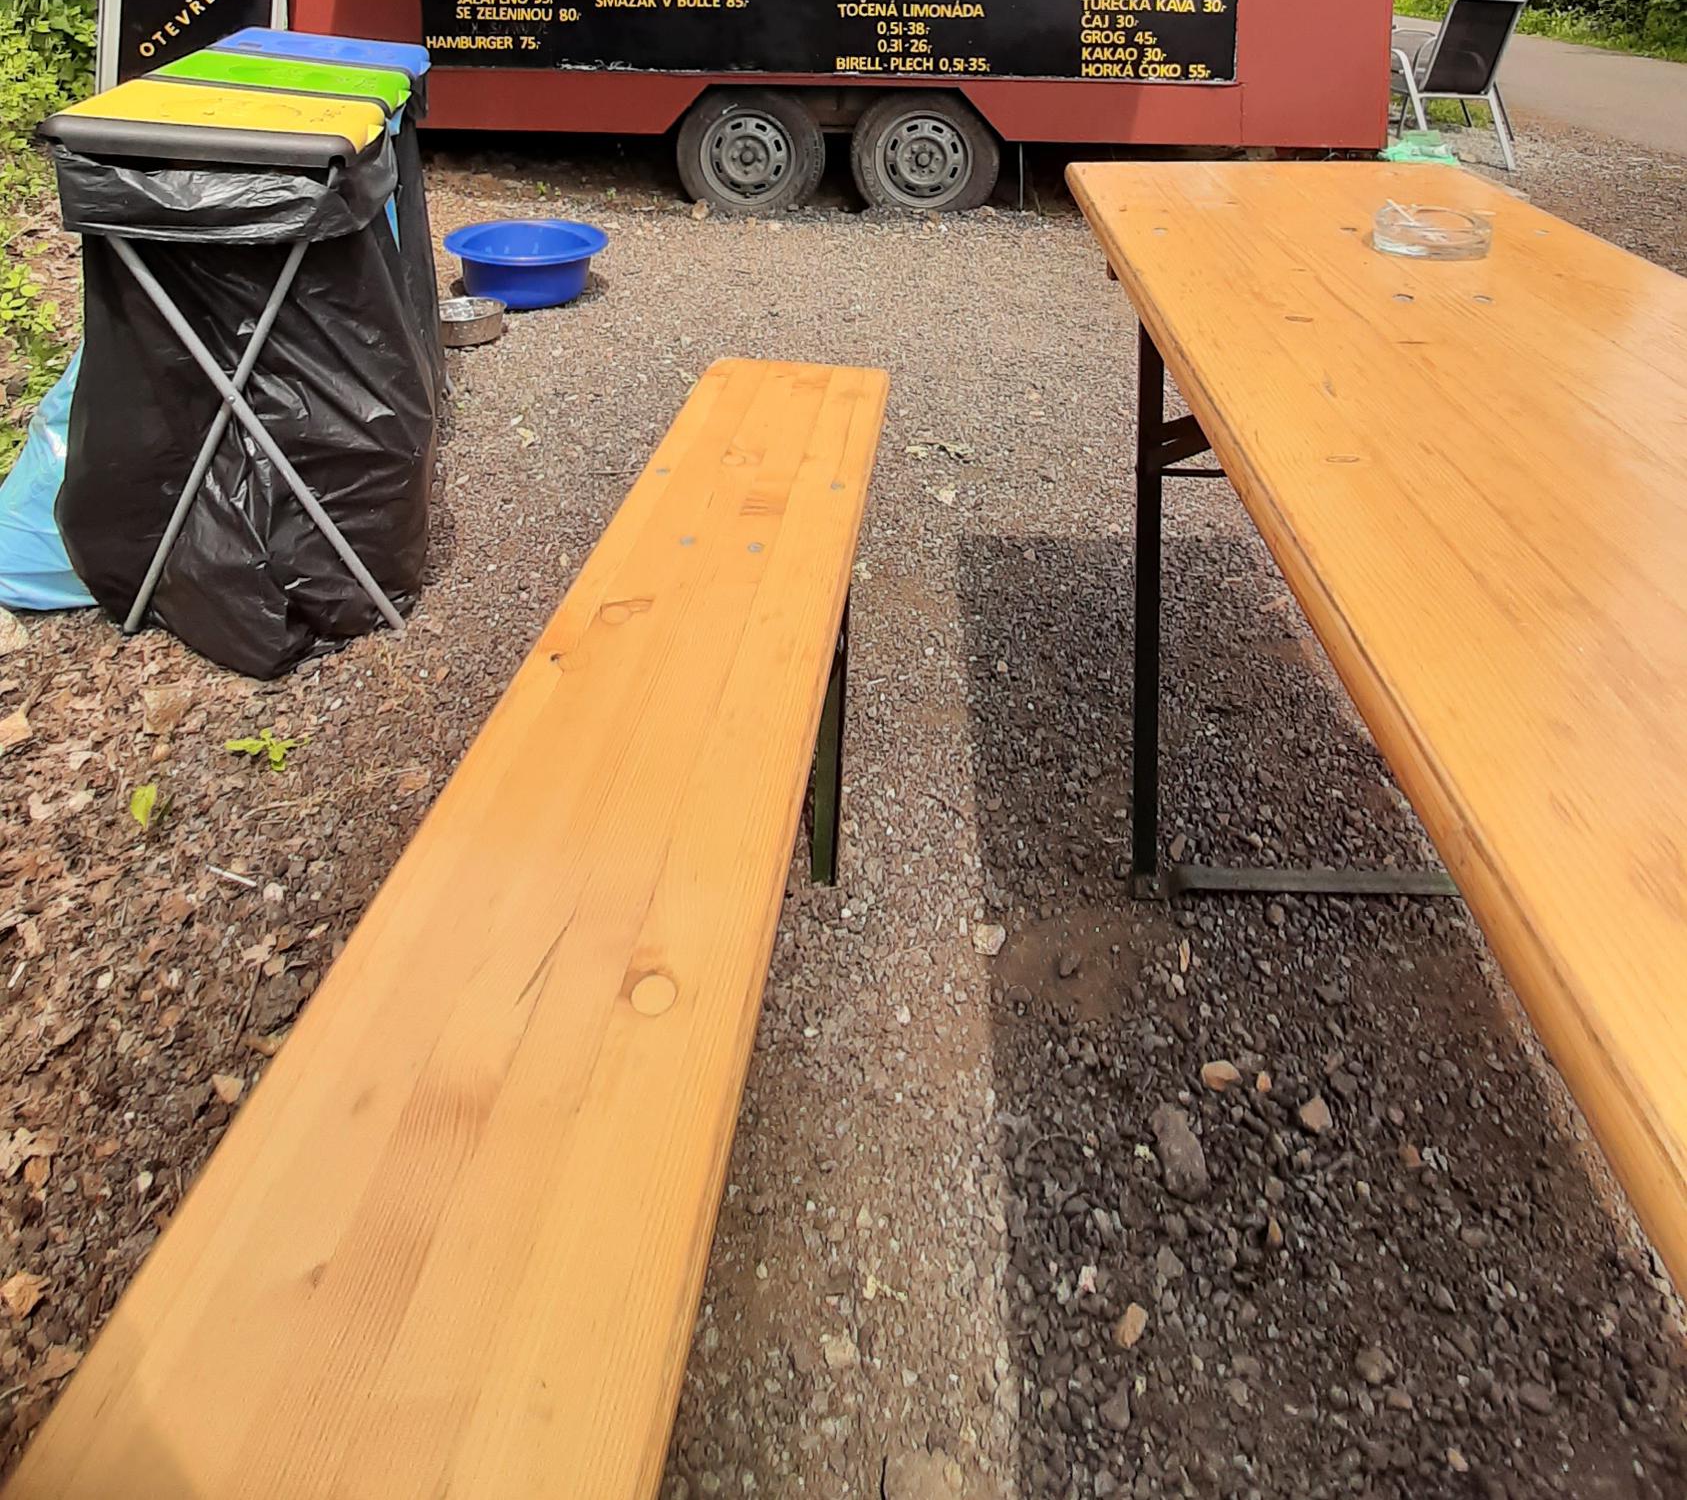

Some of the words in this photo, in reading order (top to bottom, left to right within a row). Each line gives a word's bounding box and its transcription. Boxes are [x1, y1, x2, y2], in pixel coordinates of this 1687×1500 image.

[456, 7, 471, 19] SE
[477, 8, 552, 21] ZELENINOU
[903, 0, 984, 17] LIMONÁDA
[1081, 11, 1109, 28] ČAJ
[426, 36, 513, 49] HAMBURGER
[1081, 30, 1125, 44] GROG
[1082, 47, 1137, 60] KAKAO
[1081, 61, 1134, 77] HORKÁ
[1139, 60, 1181, 77] ČOKO
